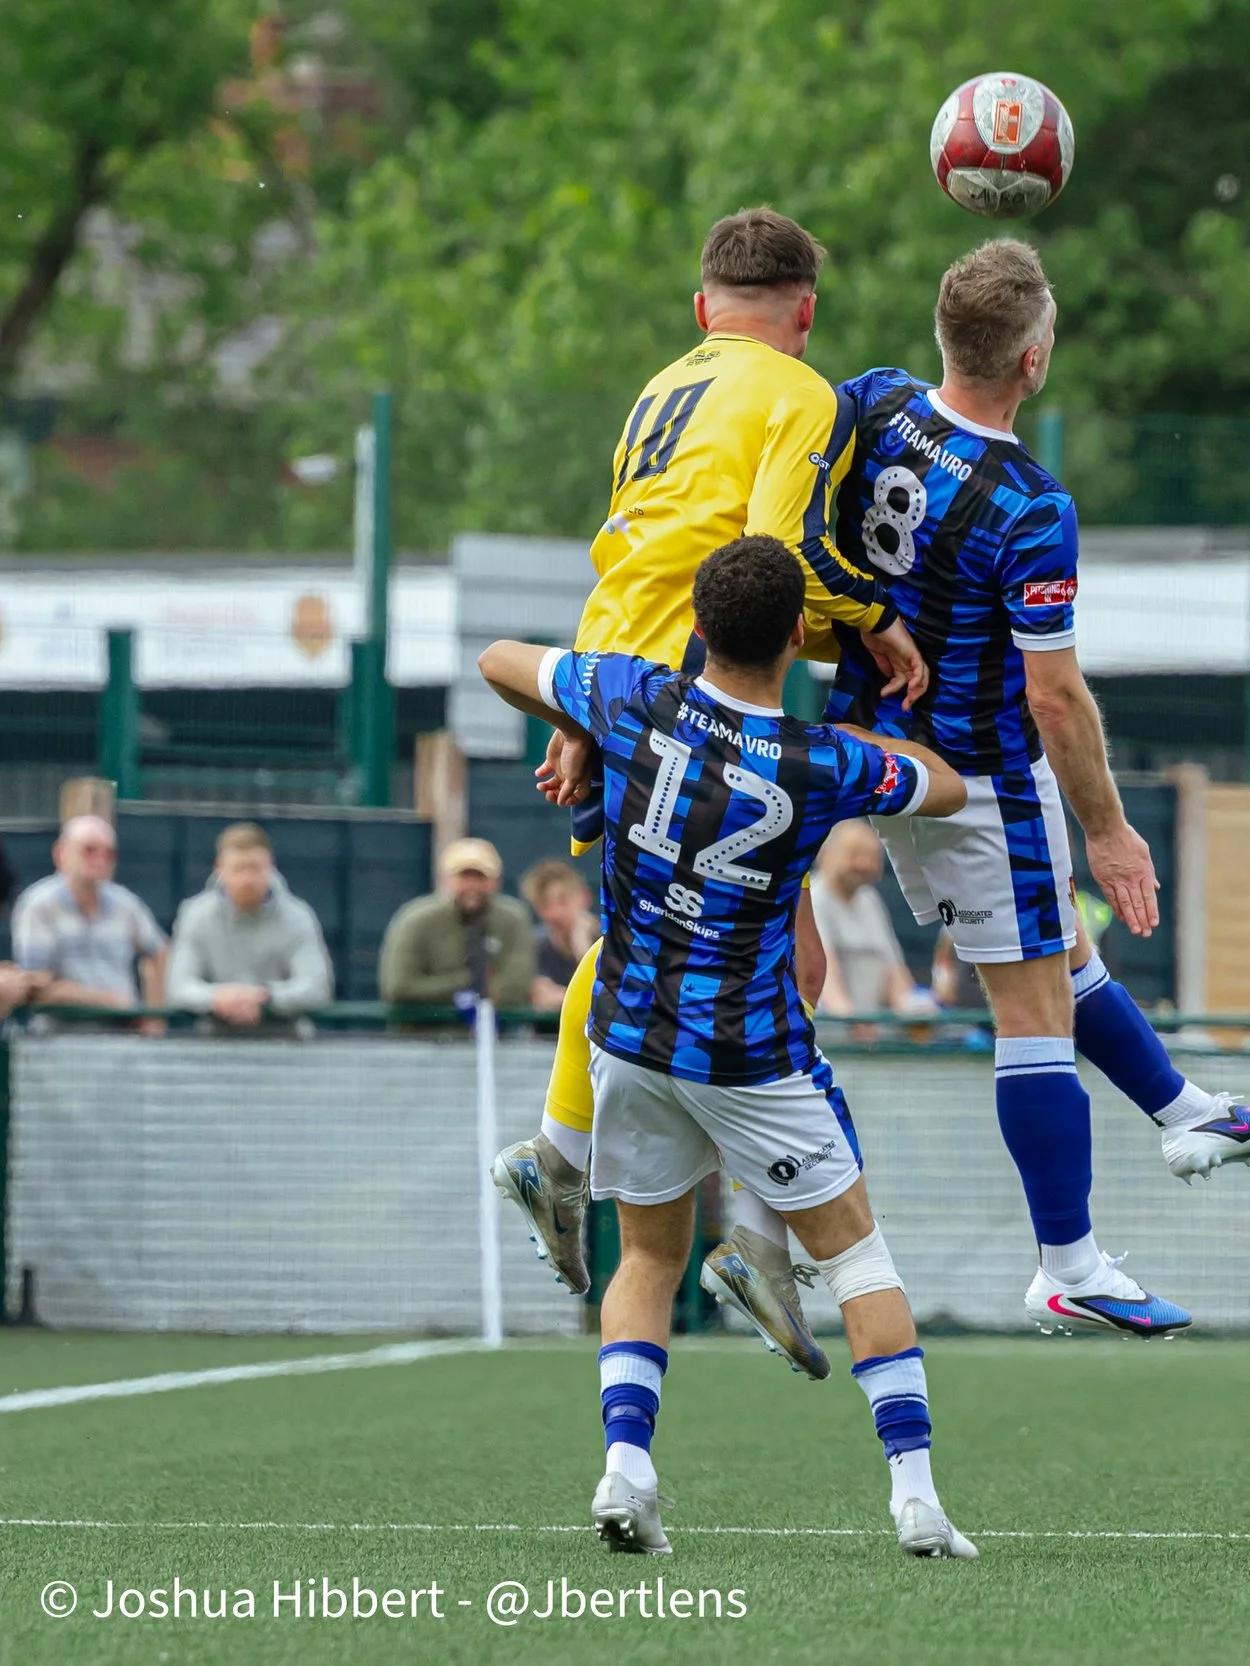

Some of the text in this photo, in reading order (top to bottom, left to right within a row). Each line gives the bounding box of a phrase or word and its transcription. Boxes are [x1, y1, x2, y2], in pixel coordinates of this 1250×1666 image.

[616, 376, 718, 492] 10
[888, 411, 973, 482] #TEAMAVRO
[861, 465, 927, 576] 8
[676, 702, 782, 760] #TEAMAVRO
[628, 728, 793, 890] 12
